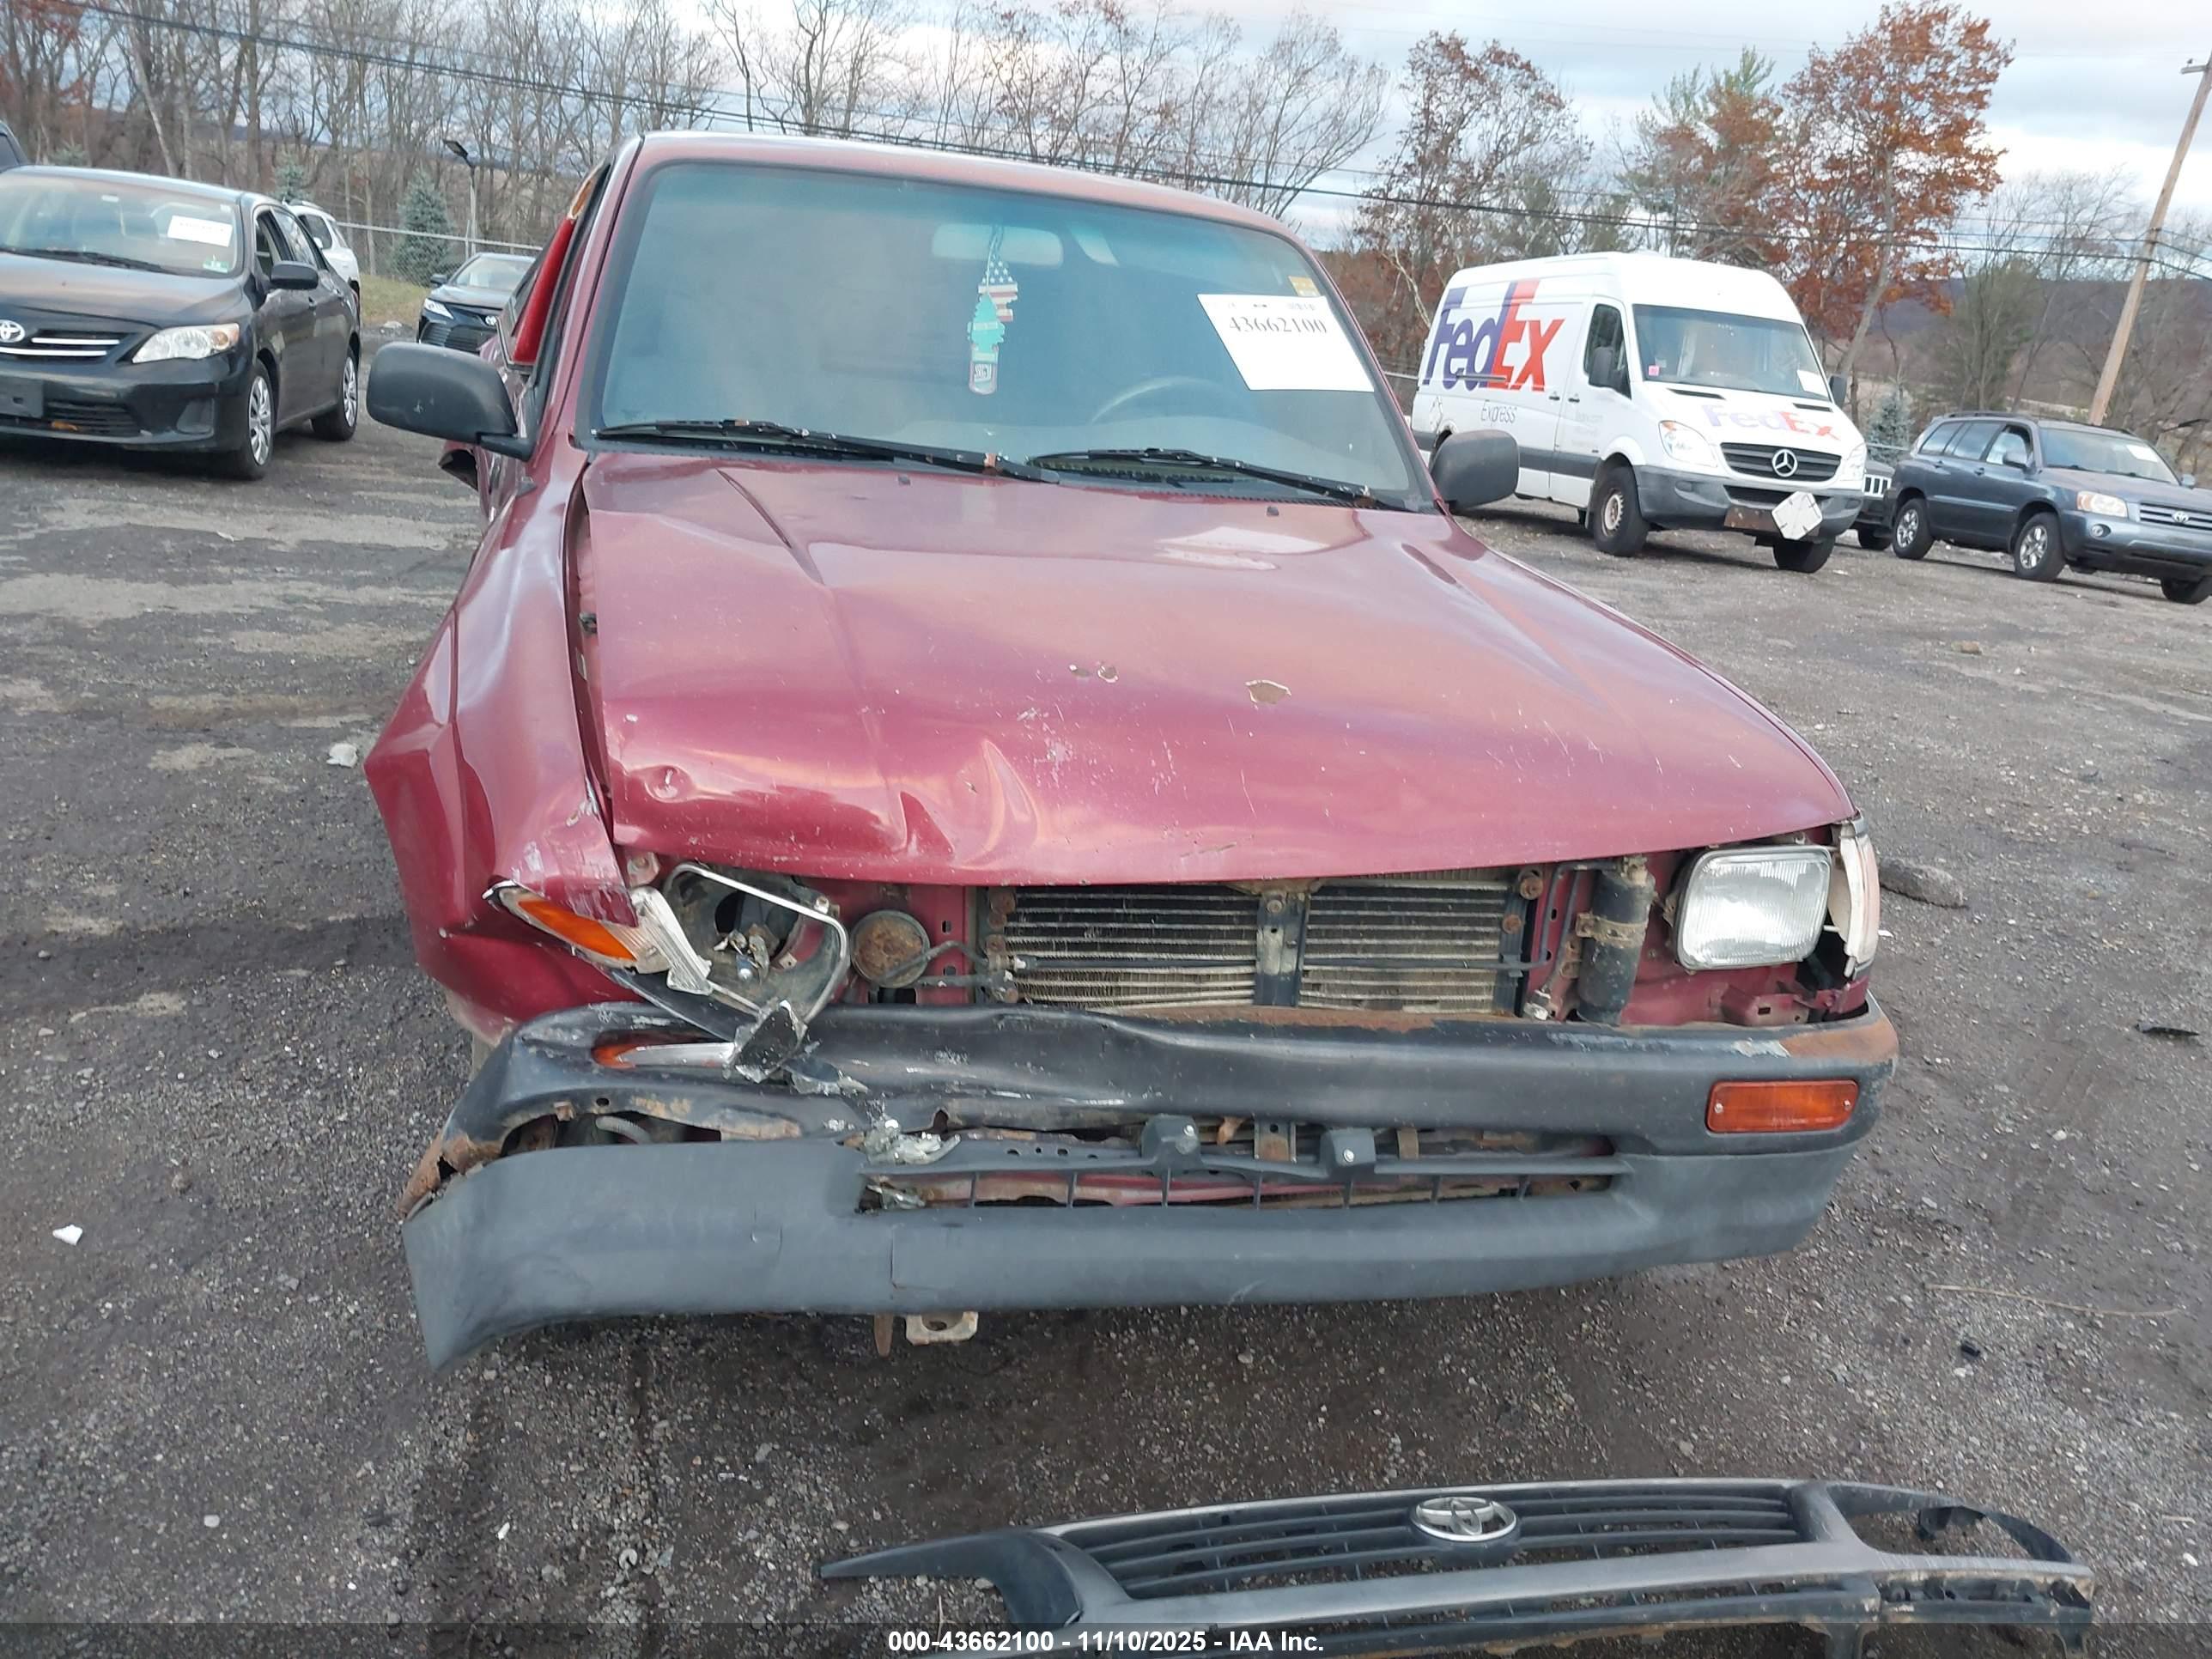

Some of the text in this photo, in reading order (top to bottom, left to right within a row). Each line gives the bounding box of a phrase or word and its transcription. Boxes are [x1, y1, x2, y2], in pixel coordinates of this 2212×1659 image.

[1230, 316, 1328, 334] 43662100
[1422, 276, 1565, 392] FedEx
[1480, 399, 1517, 427] Express
[1701, 404, 1841, 441] FedEx
